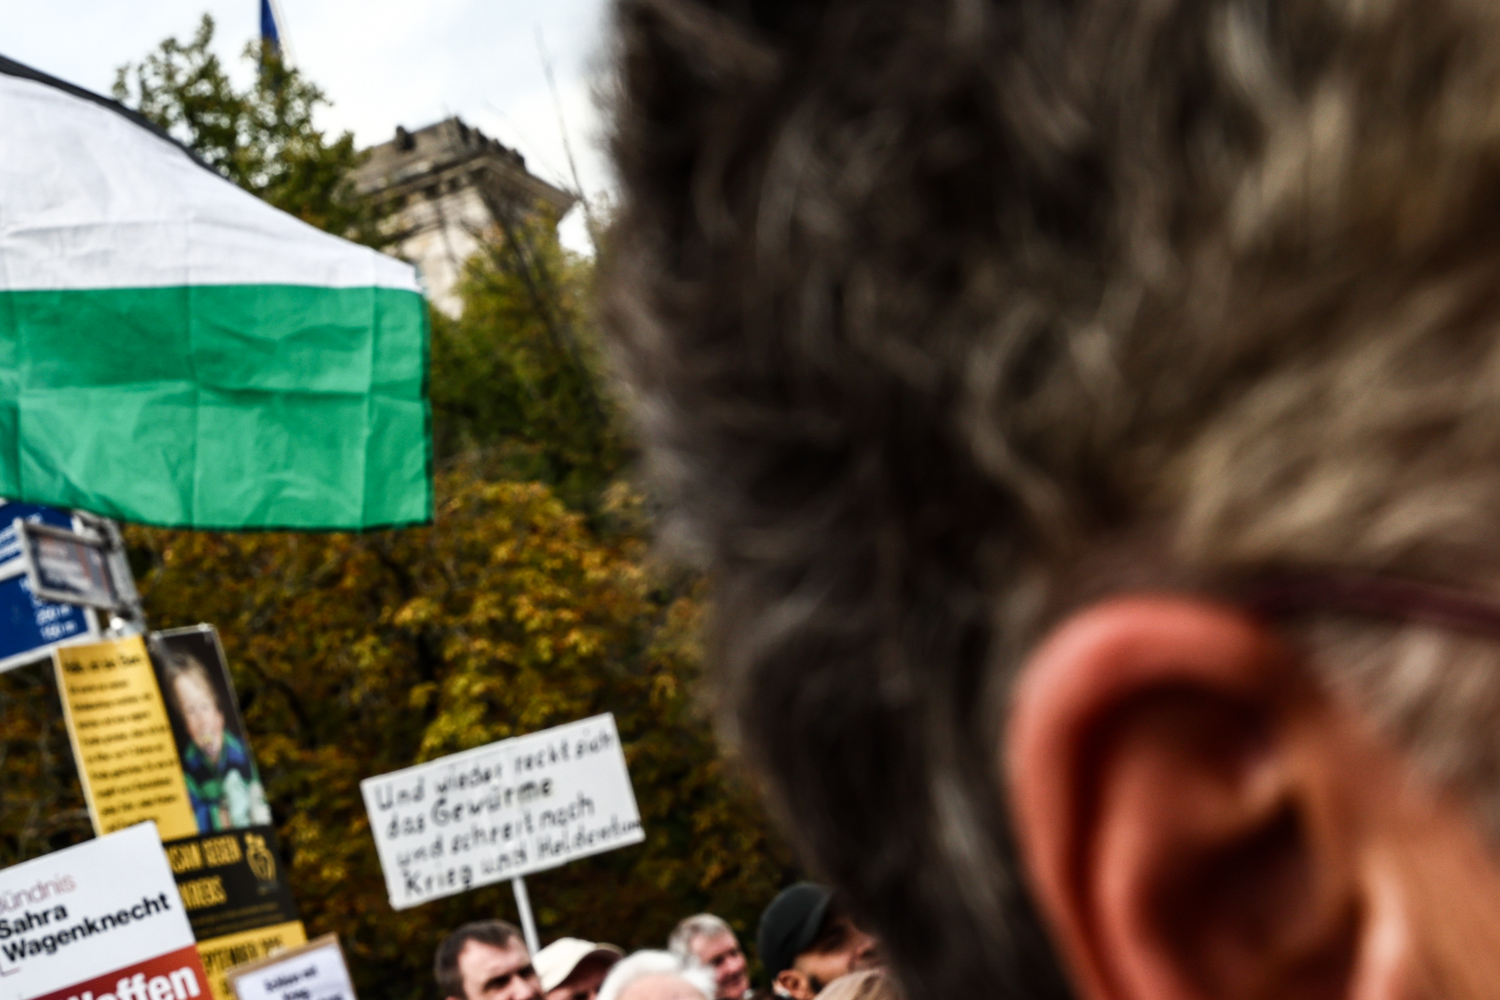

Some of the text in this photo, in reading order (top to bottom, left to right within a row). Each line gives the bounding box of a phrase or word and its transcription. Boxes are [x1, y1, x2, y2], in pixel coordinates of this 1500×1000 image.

[374, 774, 426, 812] Und
[435, 760, 503, 797] wieder
[513, 739, 570, 775] reckt
[386, 774, 555, 841] das Gewürme
[396, 835, 444, 869] und
[450, 811, 536, 856] schreit
[402, 861, 473, 898] Krieg
[481, 841, 529, 877] und
[1, 891, 172, 965] Wagenknecht
